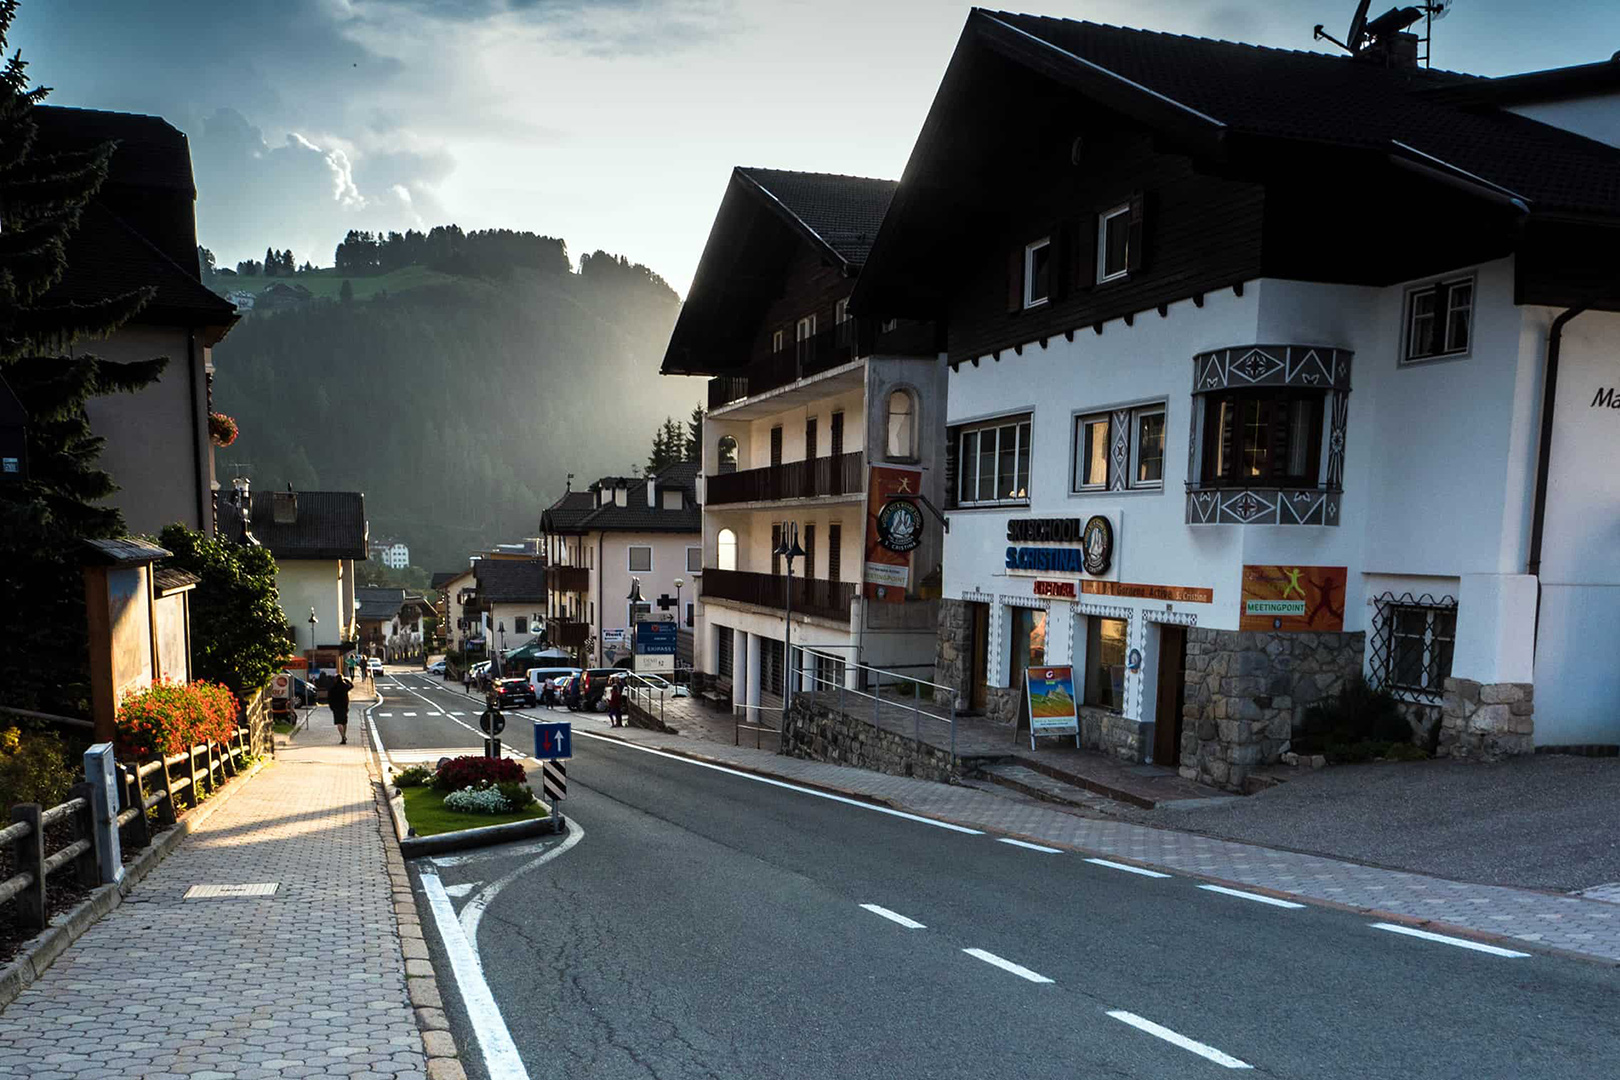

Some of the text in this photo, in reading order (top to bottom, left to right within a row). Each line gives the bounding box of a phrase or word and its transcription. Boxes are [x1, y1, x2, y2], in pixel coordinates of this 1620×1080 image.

[1007, 519, 1026, 541] SKI
[1026, 519, 1080, 542] SCHOOL
[1182, 592, 1207, 602] Cristina
[1247, 603, 1304, 612] MEETINGPOINT
